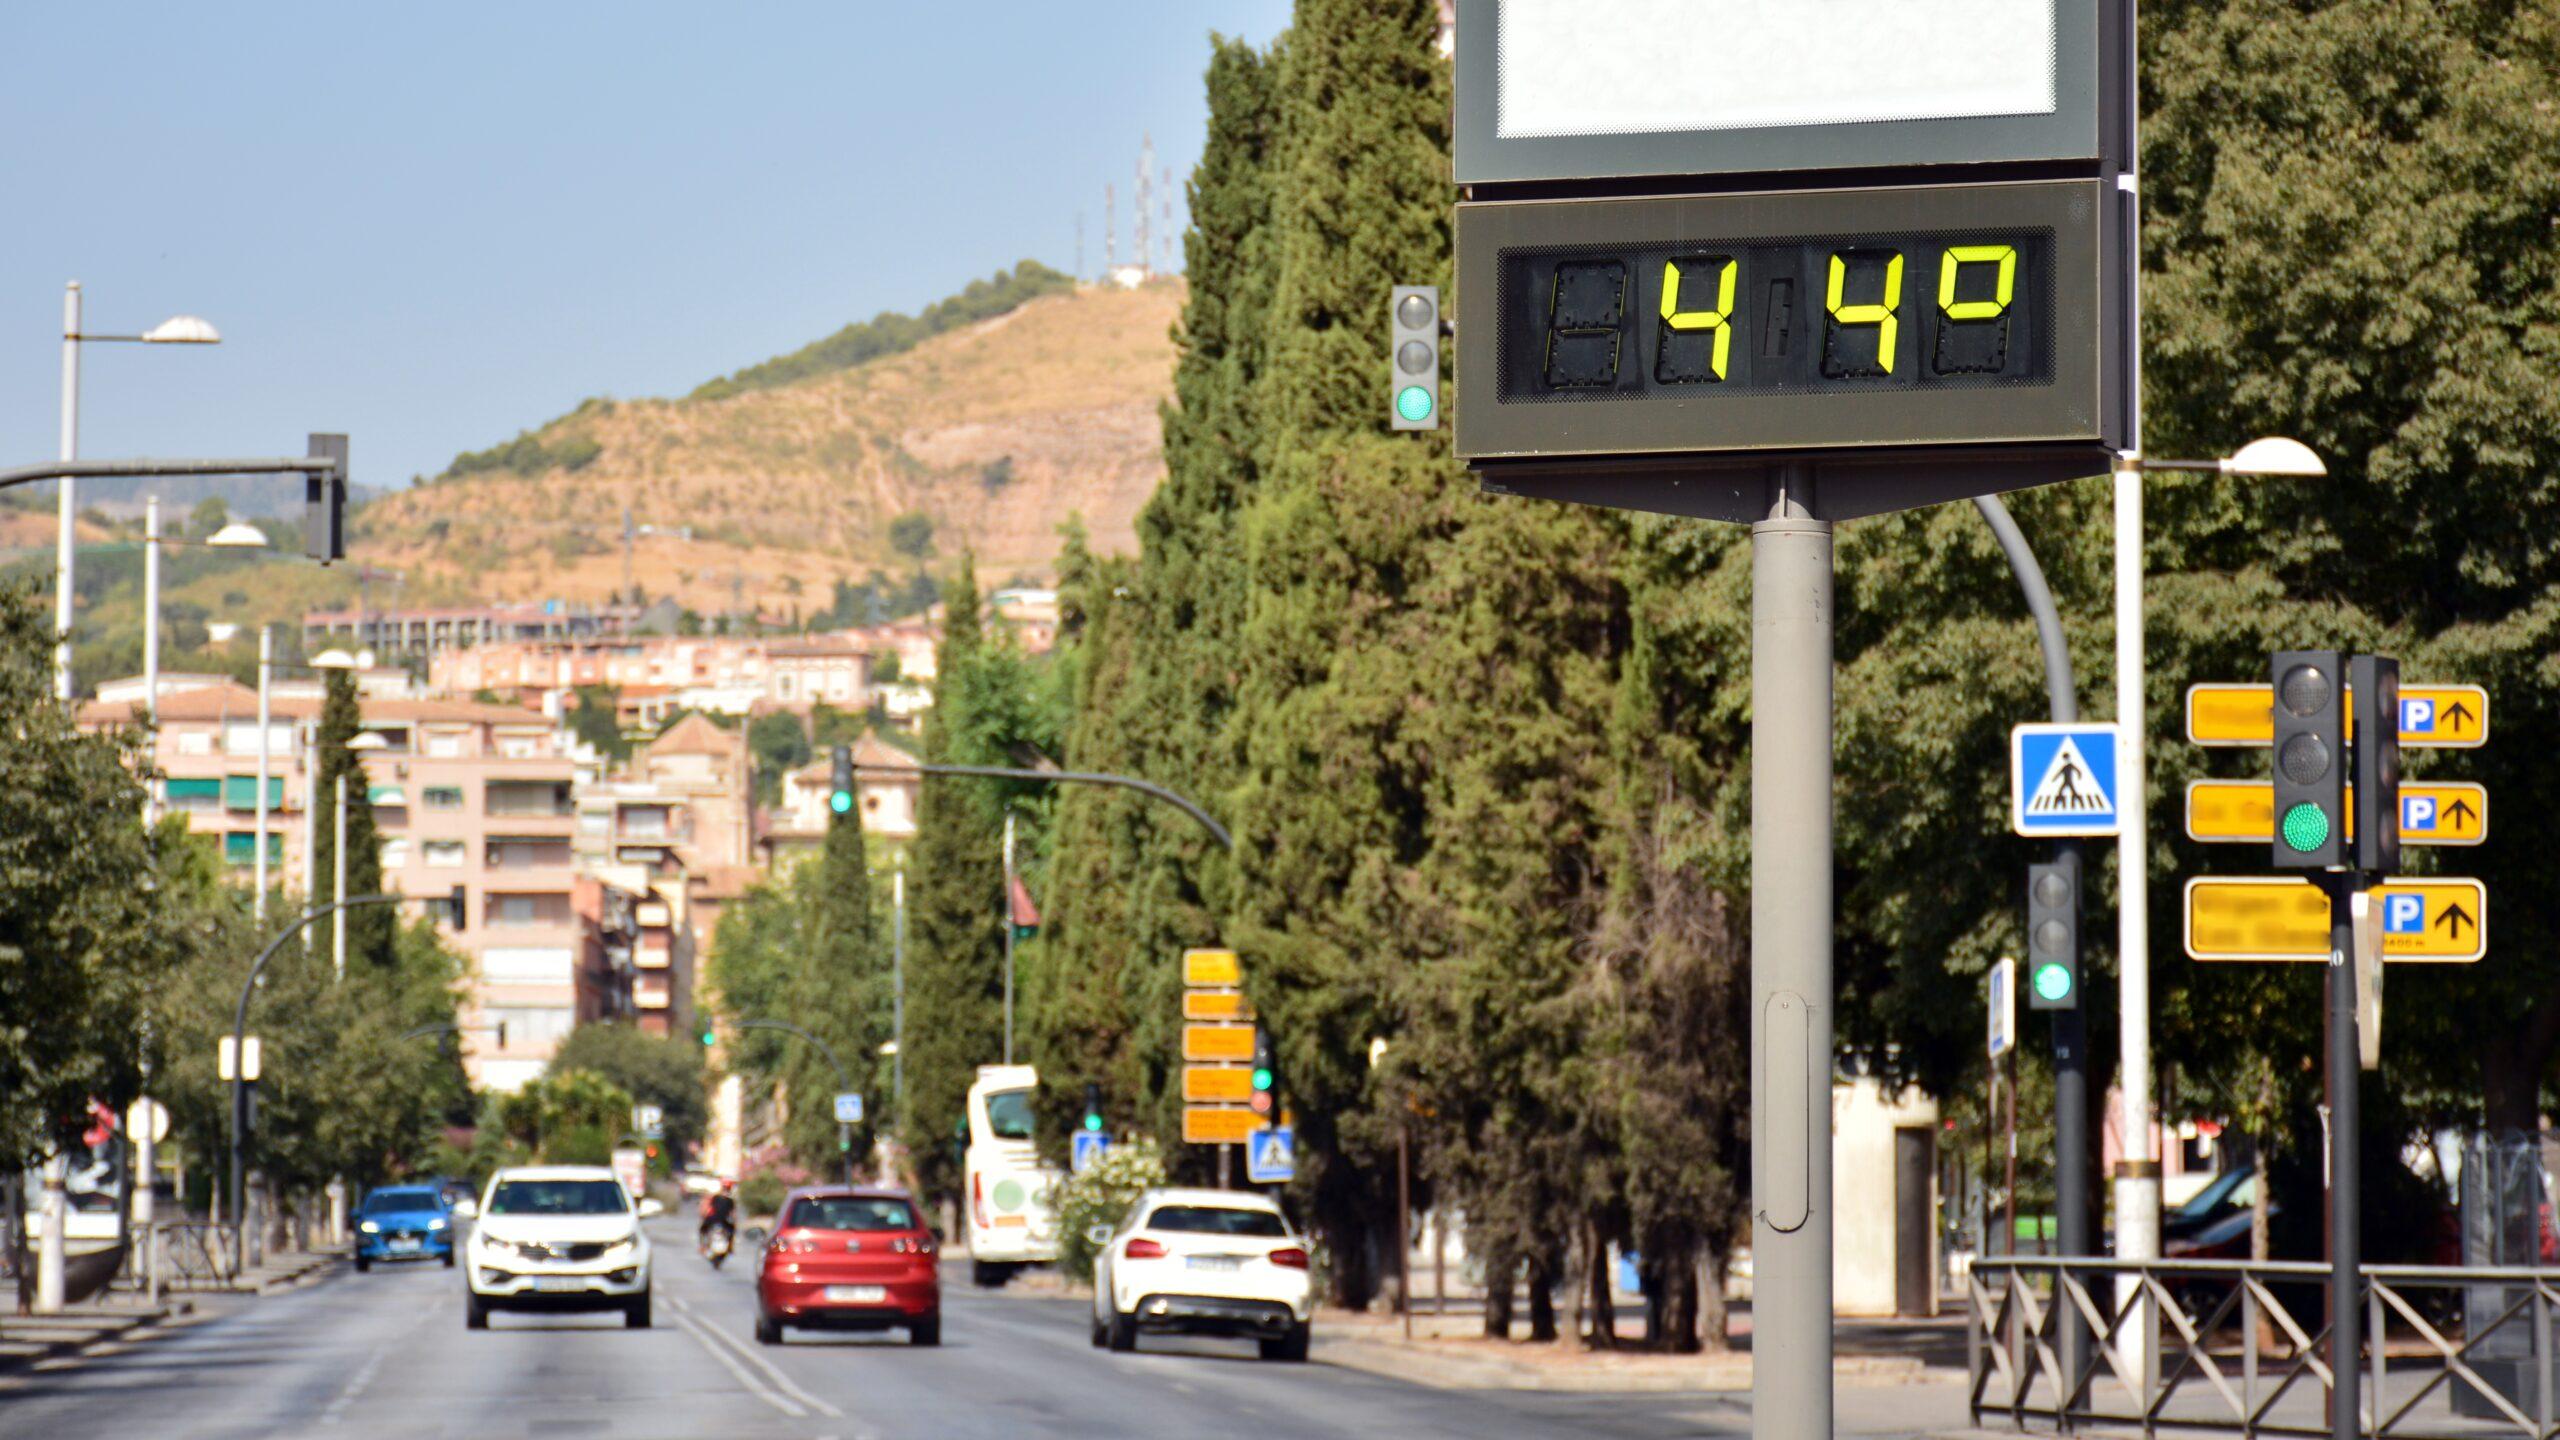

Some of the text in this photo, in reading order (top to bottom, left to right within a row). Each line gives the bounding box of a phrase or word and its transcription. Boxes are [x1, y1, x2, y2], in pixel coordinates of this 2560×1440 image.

[2406, 700, 2431, 731] P
[2408, 798, 2433, 829] P
[2392, 896, 2420, 931] P
